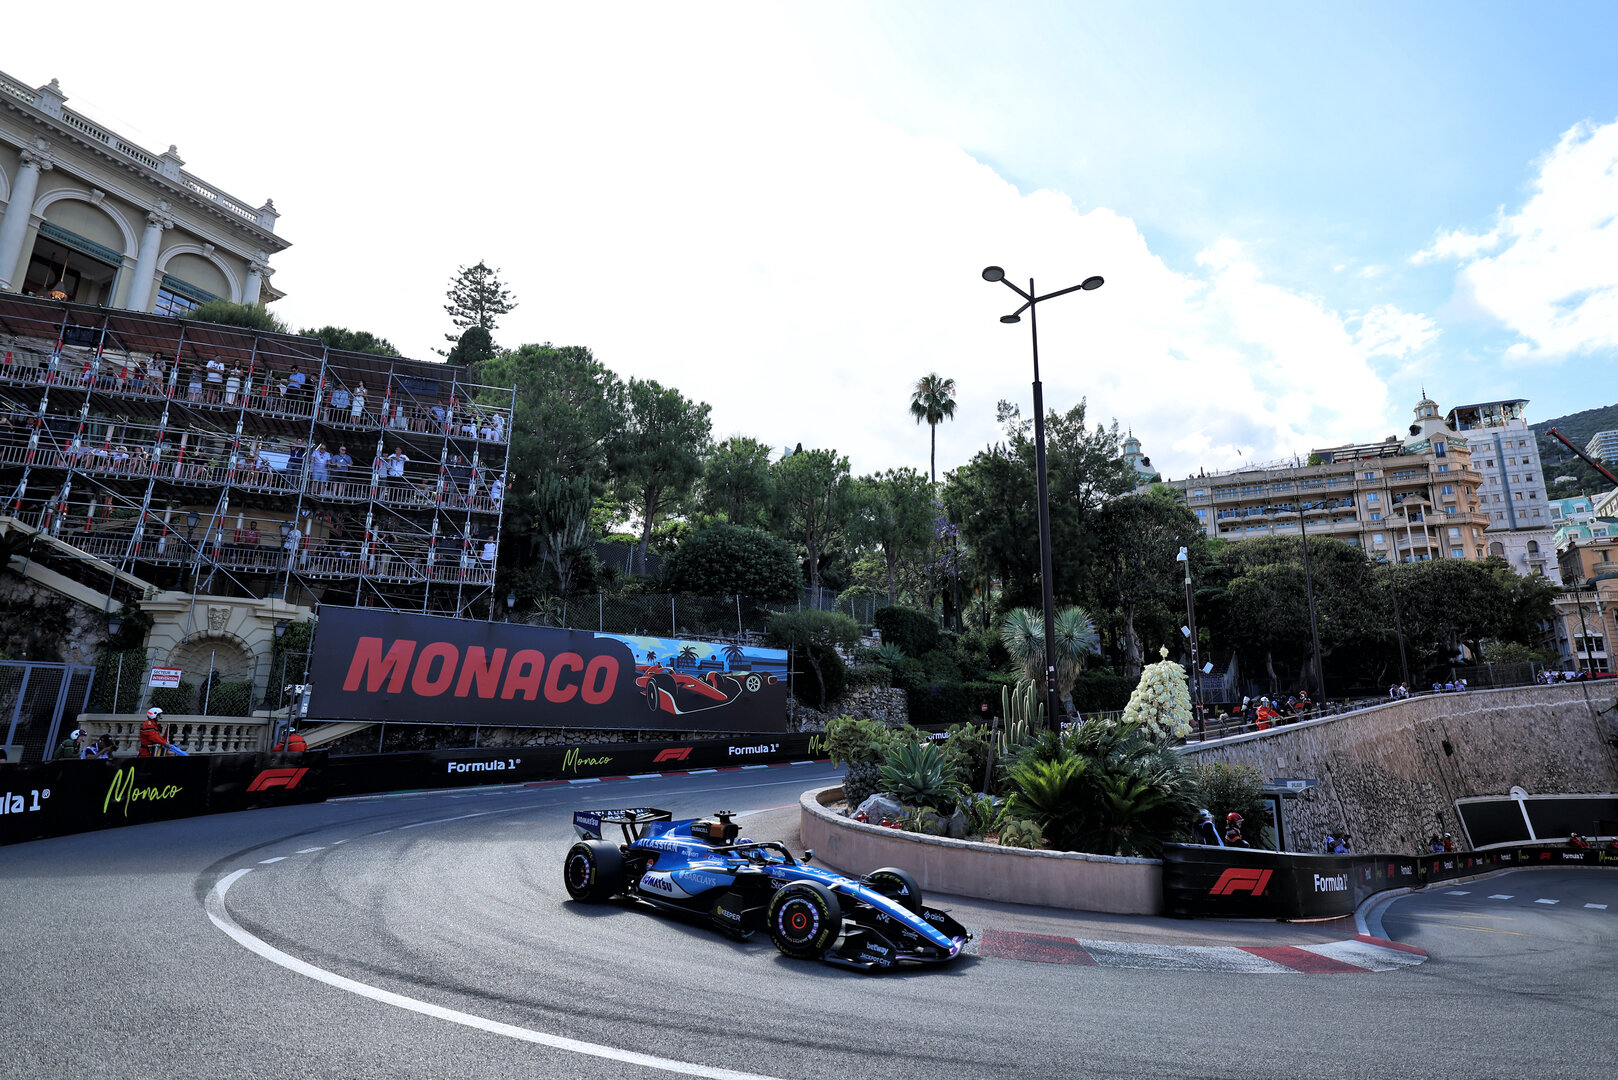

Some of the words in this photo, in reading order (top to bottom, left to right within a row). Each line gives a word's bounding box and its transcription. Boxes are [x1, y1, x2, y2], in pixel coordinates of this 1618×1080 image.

[342, 636, 620, 705] MONACO
[652, 747, 694, 763] F1
[728, 744, 769, 756] Formula
[447, 759, 506, 774] Formula
[561, 747, 614, 774] Monaco
[246, 767, 310, 792] F1
[103, 766, 183, 818] Monaco
[576, 815, 599, 827] KOMATSU
[637, 838, 679, 853] ATLASSIAN
[641, 874, 673, 892] KOMATSU
[684, 872, 717, 887] BARCLAYS
[1208, 867, 1274, 896] F1
[1313, 873, 1343, 893] Formula
[721, 908, 741, 922] KEEPER
[866, 941, 890, 956] betway
[860, 952, 880, 963] JACKPOT
[879, 957, 892, 967] CITY
